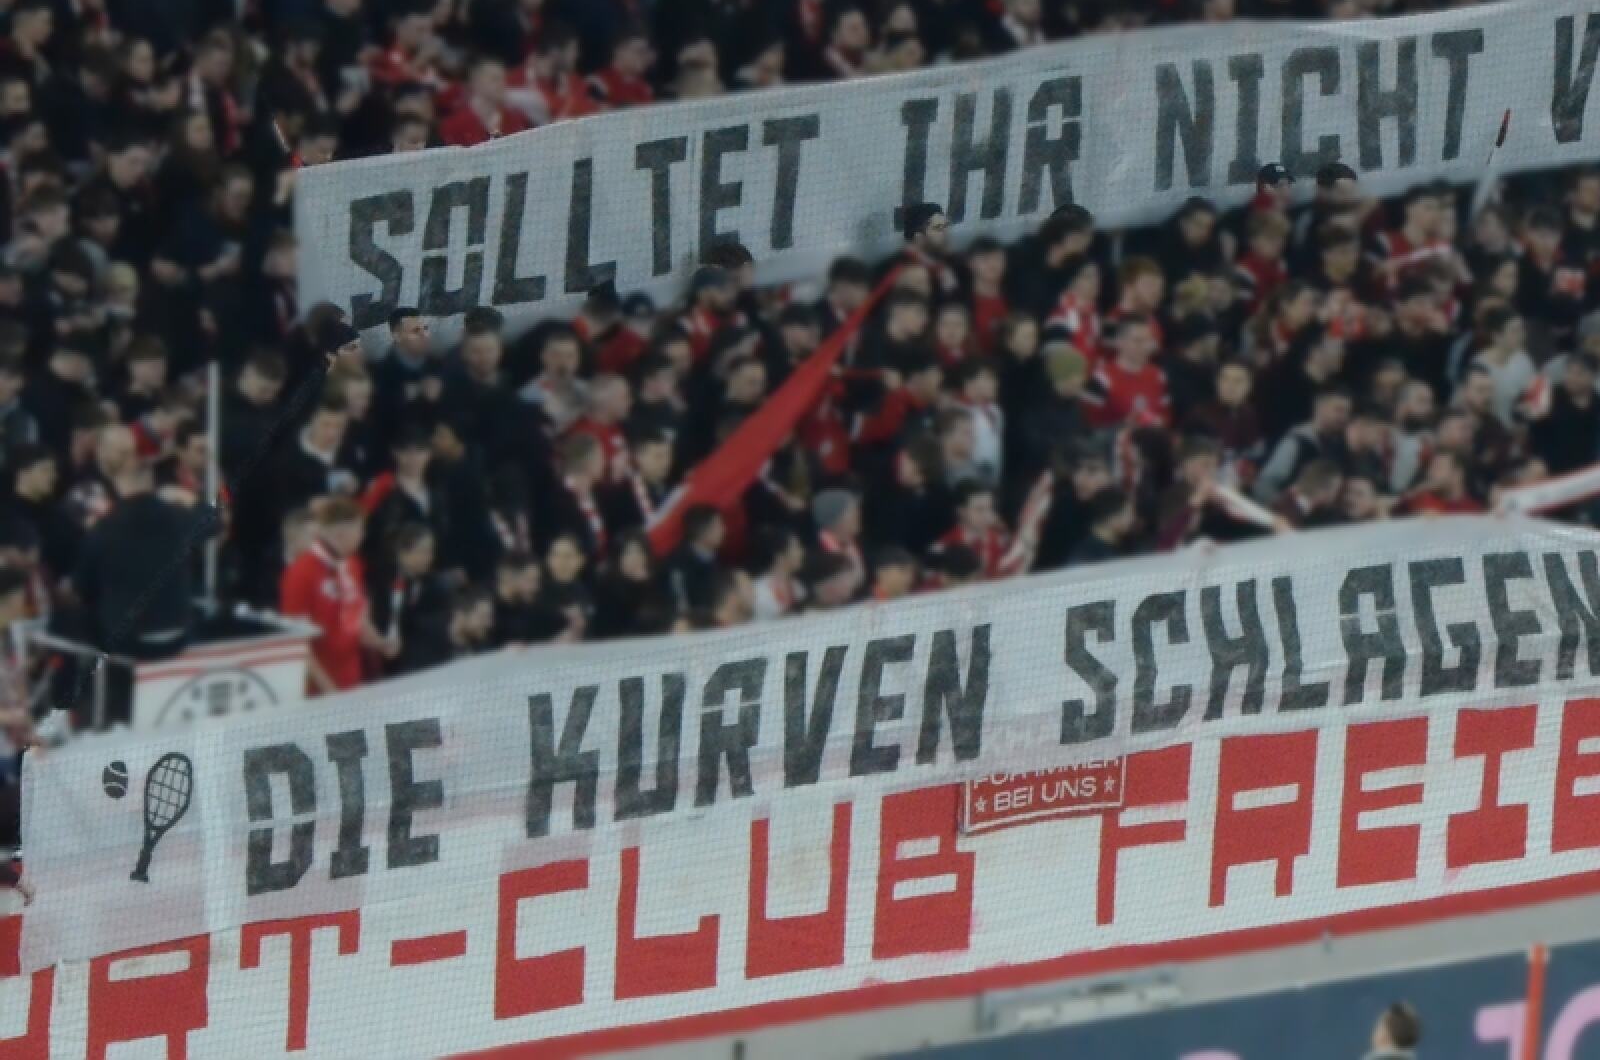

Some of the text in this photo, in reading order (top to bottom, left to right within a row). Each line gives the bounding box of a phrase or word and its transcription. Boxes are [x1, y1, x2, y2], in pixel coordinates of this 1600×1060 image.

[349, 113, 820, 331] SOLLTET
[894, 75, 1082, 230] IHR
[1155, 28, 1484, 192] NICHT
[244, 717, 443, 896] DIE
[526, 623, 992, 839] KURVEN
[994, 776, 1097, 813] BEI UNS
